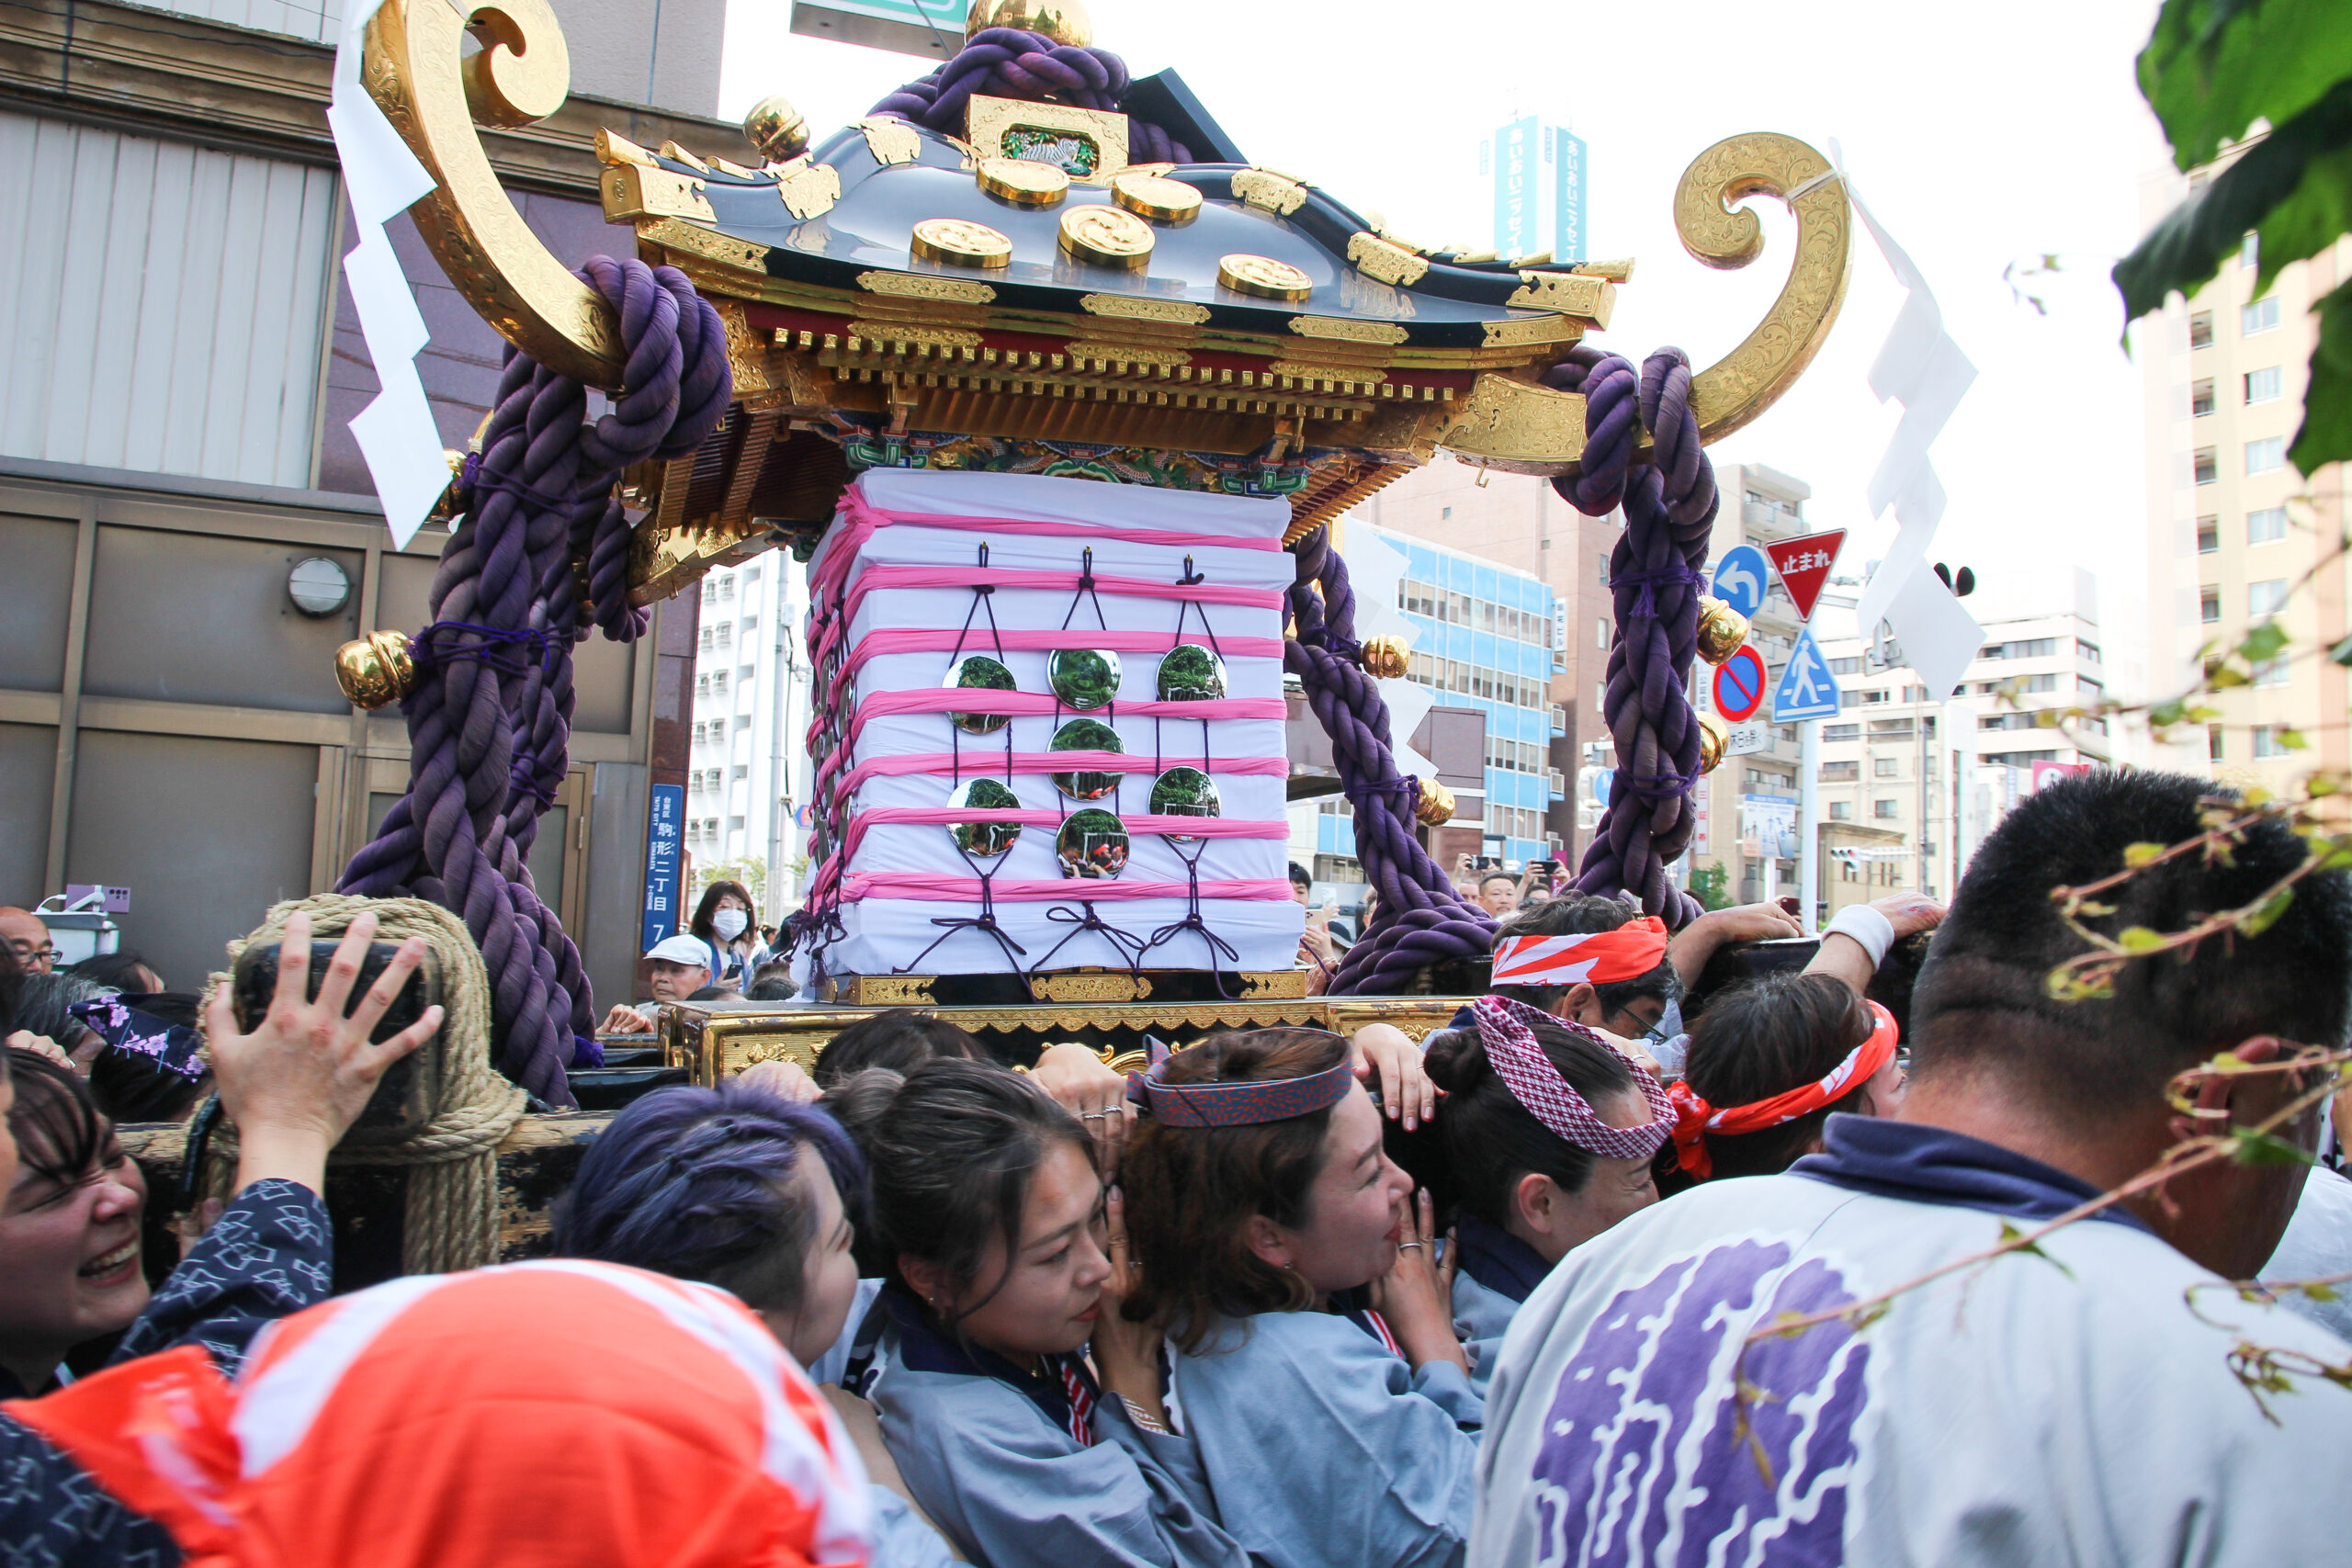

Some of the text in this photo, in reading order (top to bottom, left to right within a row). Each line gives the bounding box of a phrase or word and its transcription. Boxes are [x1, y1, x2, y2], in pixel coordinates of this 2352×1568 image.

[1566, 140, 1578, 260] あいおいニッセイ
[1781, 549, 1831, 575] 止まれ
[662, 795, 672, 818] 台東区
[653, 822, 673, 911] 駒形二丁目
[652, 924, 665, 942] 7
